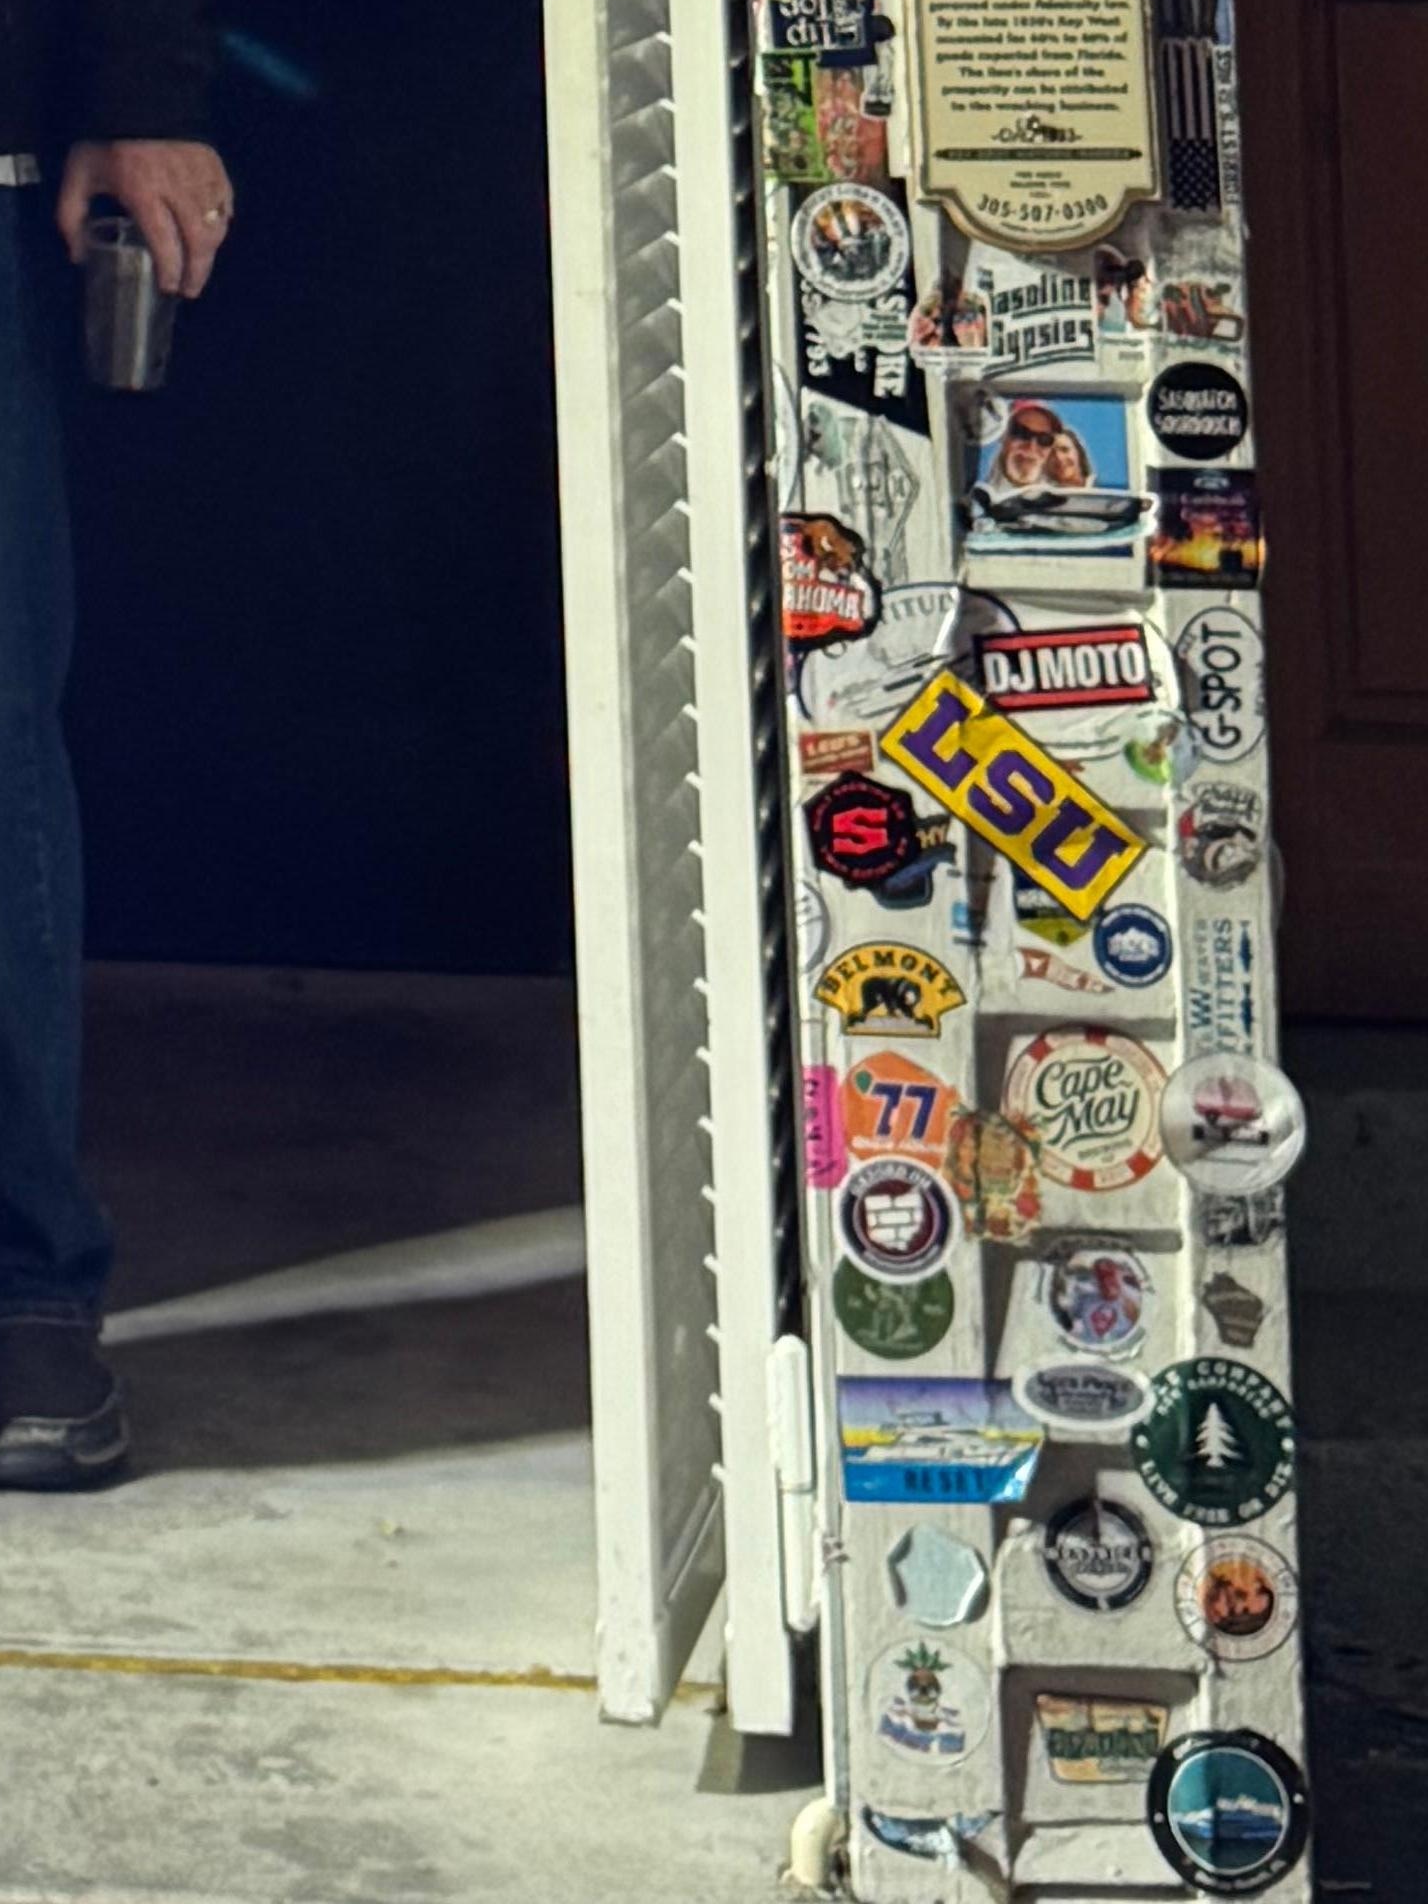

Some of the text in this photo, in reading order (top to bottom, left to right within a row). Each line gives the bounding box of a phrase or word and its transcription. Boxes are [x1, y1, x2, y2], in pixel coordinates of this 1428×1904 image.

[984, 643, 1144, 693] DJ MOTO
[1202, 620, 1244, 751] G-SPOT
[901, 686, 1133, 892] LSU
[819, 947, 964, 1000] BELMONT
[870, 1081, 937, 1140] 77
[1035, 1056, 1125, 1107] Cape
[1045, 1088, 1141, 1149] May
